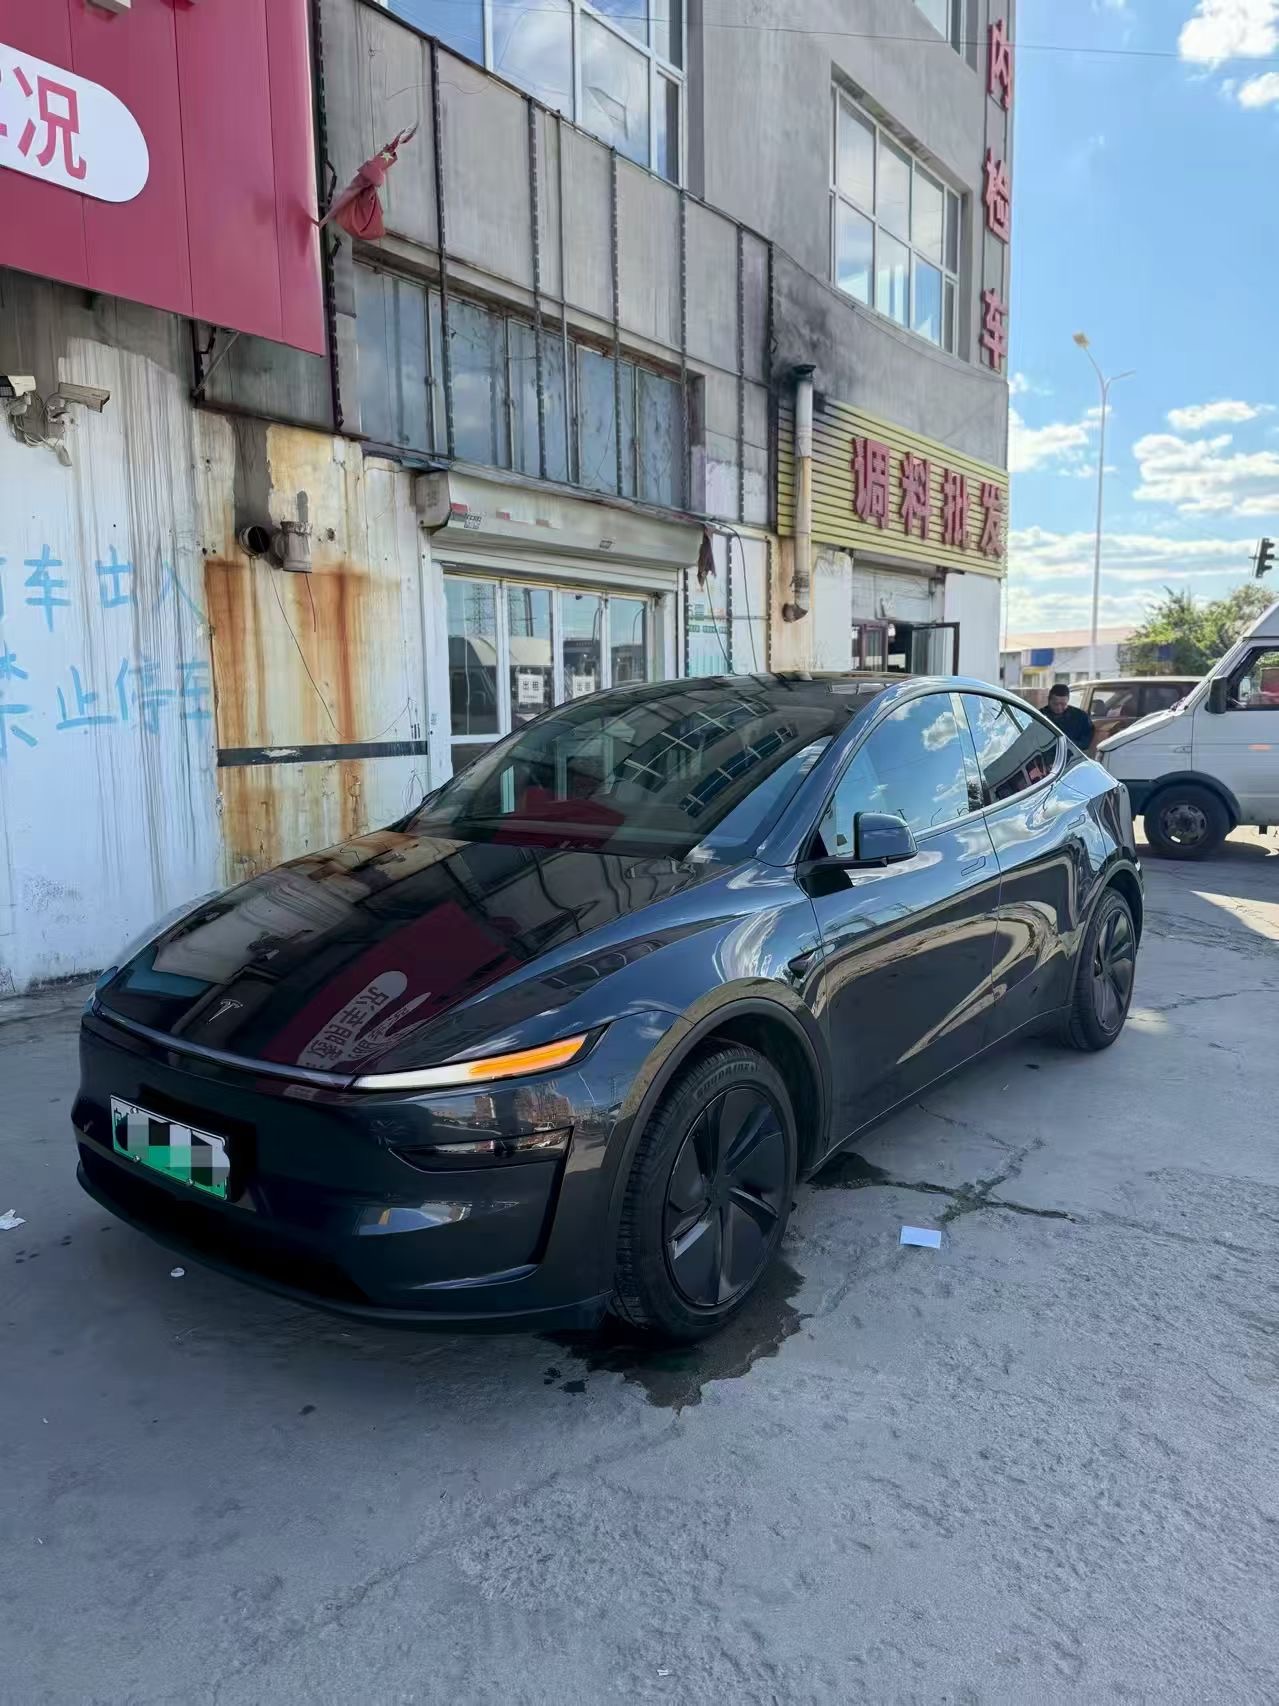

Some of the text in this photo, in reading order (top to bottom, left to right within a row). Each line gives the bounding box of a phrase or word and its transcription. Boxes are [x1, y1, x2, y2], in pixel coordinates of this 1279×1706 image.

[0, 66, 87, 180] 况
[850, 436, 1004, 558] 调料批发
[0, 544, 207, 632] 车出入
